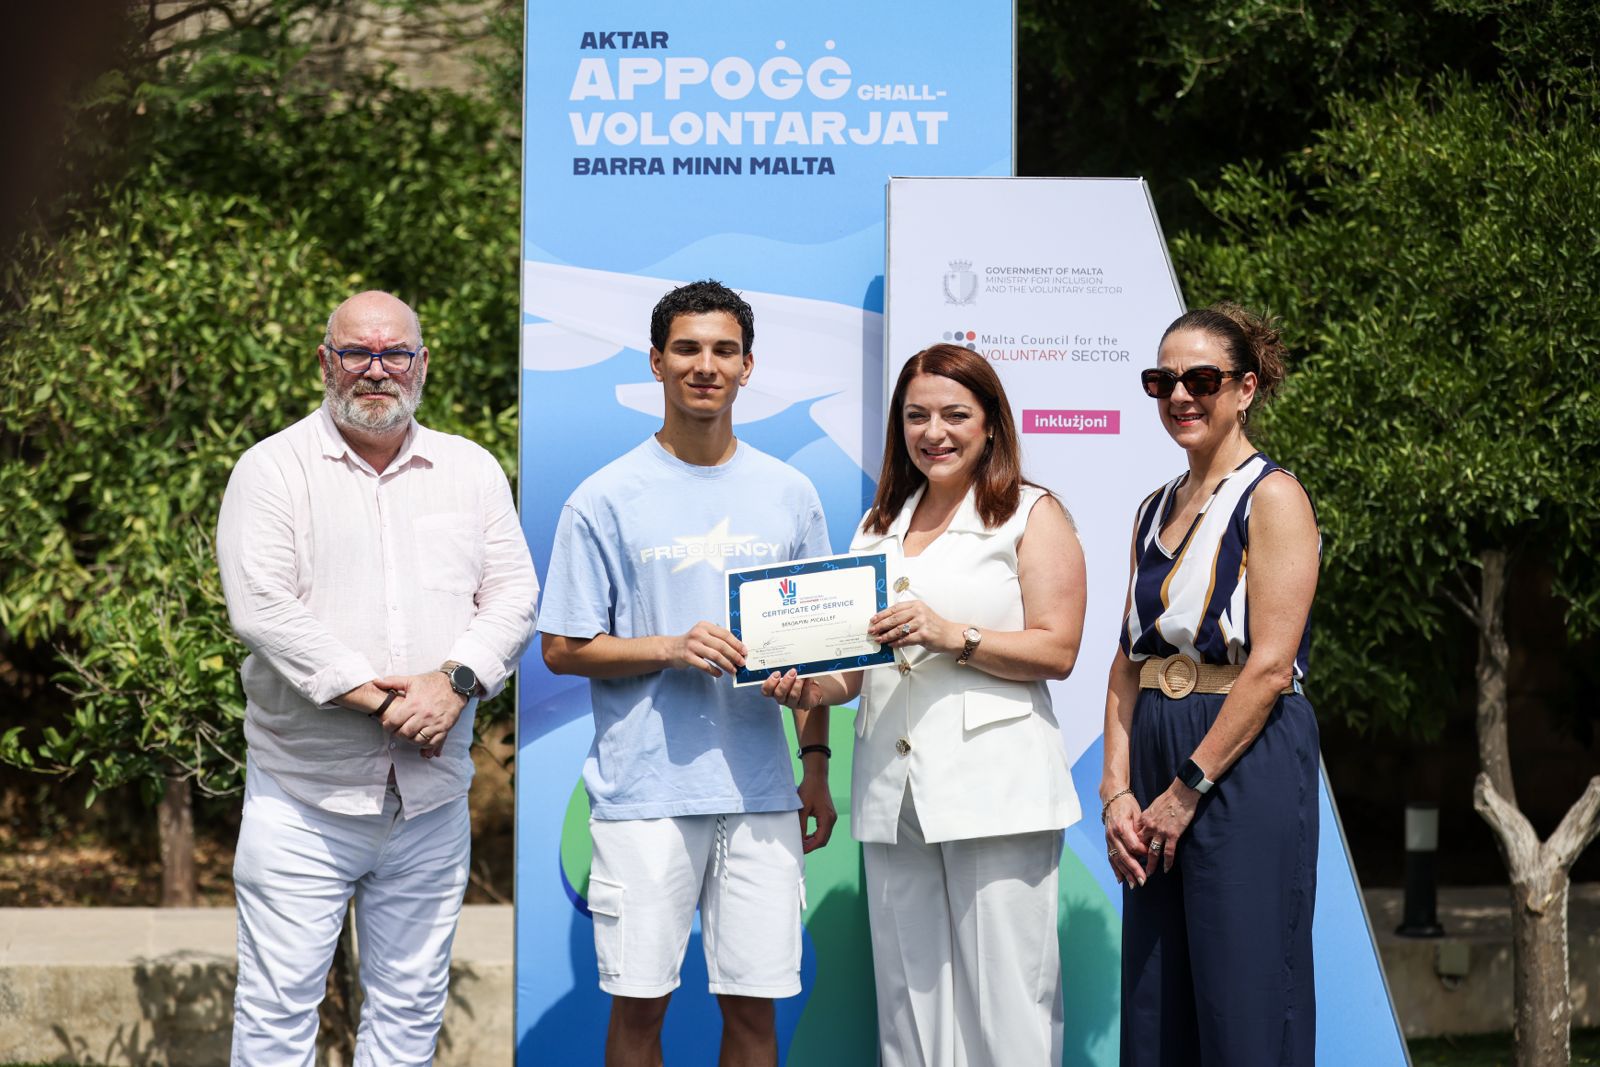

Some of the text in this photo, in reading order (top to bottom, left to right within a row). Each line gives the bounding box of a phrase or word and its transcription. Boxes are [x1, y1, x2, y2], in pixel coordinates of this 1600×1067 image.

[580, 31, 669, 49] AKTAR
[569, 40, 852, 101] APPOĠĠ
[569, 111, 949, 146] VOLONTARJAT
[573, 157, 835, 175] BARRA MINN MALTA
[985, 266, 1103, 276] GOVERNMENT OF MALTA
[985, 276, 1103, 285] MINISTRY FOR INCLUSION
[985, 285, 1123, 295] AND THE VOLUNTARY SECTOR
[981, 334, 1118, 346] Malta Council for the
[981, 349, 1130, 362] VOLUNTARY SECTOR
[1035, 415, 1107, 430] inklużjoni
[640, 542, 781, 564] FREQUENCY
[782, 597, 797, 606] 26
[762, 606, 809, 618] CERTIFICATE
[810, 604, 821, 612] OF
[822, 600, 854, 610] SERVICE
[810, 615, 836, 624] MICALLEF
